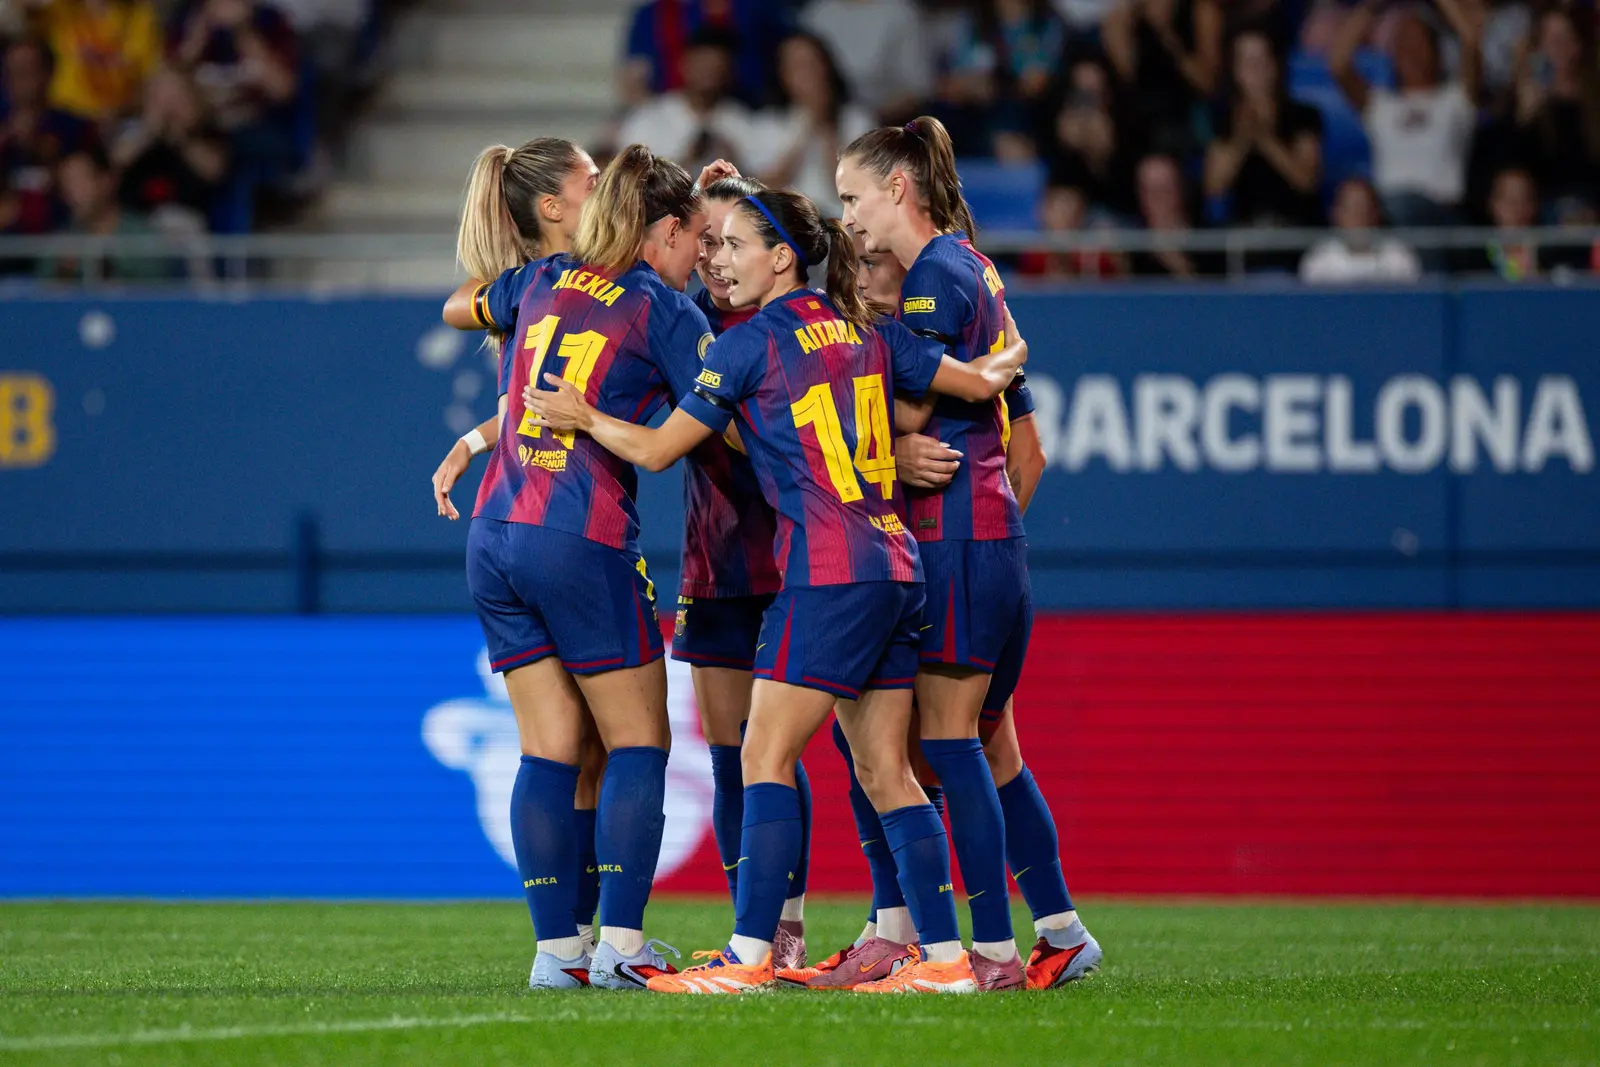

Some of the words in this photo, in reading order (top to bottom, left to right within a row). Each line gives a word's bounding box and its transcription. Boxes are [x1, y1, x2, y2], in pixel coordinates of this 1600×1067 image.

[552, 269, 626, 307] ALEXIA
[903, 299, 936, 312] BIMBO
[794, 319, 863, 355] AITANA
[1031, 373, 1596, 475] BARCELONA
[790, 373, 896, 504] 14
[534, 450, 568, 460] UNHCR
[531, 456, 567, 468] ACNUR
[597, 864, 623, 873] ARÇA
[523, 876, 558, 889] BARÇA
